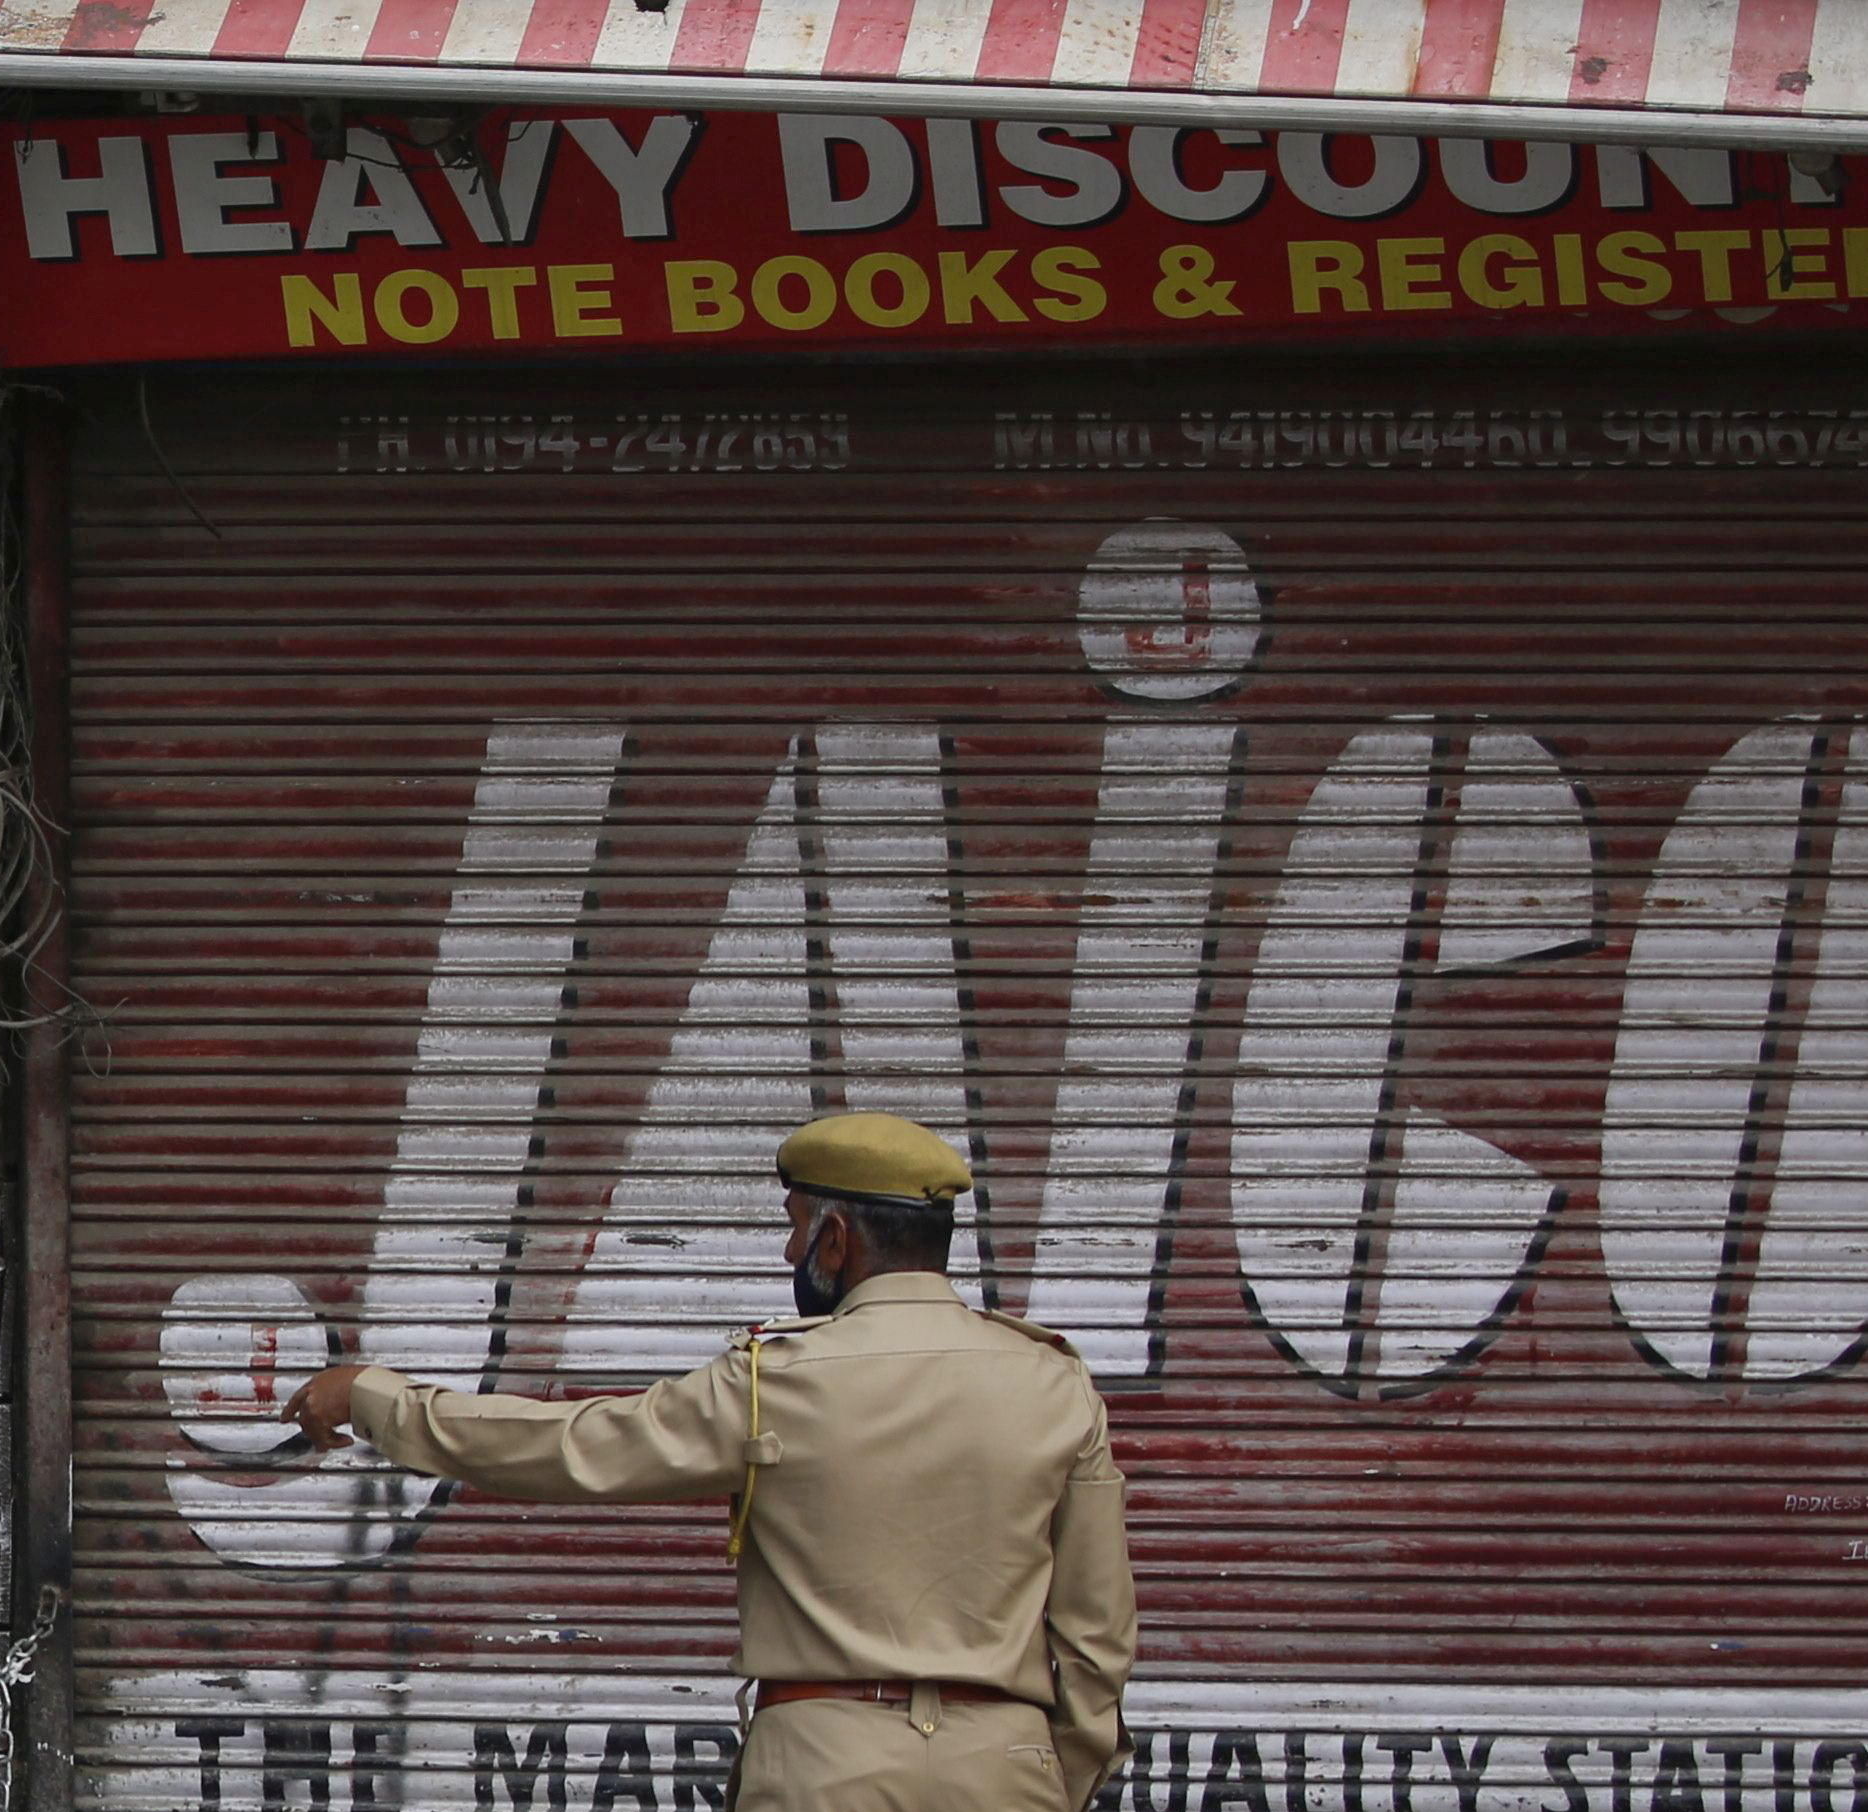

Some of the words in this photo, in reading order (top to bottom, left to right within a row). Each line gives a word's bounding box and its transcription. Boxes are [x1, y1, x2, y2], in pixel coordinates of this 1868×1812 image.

[13, 117, 692, 258] HEAVY
[776, 113, 1838, 231] DISCOUN
[281, 264, 623, 347] NOTE
[665, 246, 1107, 332] BOOKS
[1153, 244, 1244, 318] &
